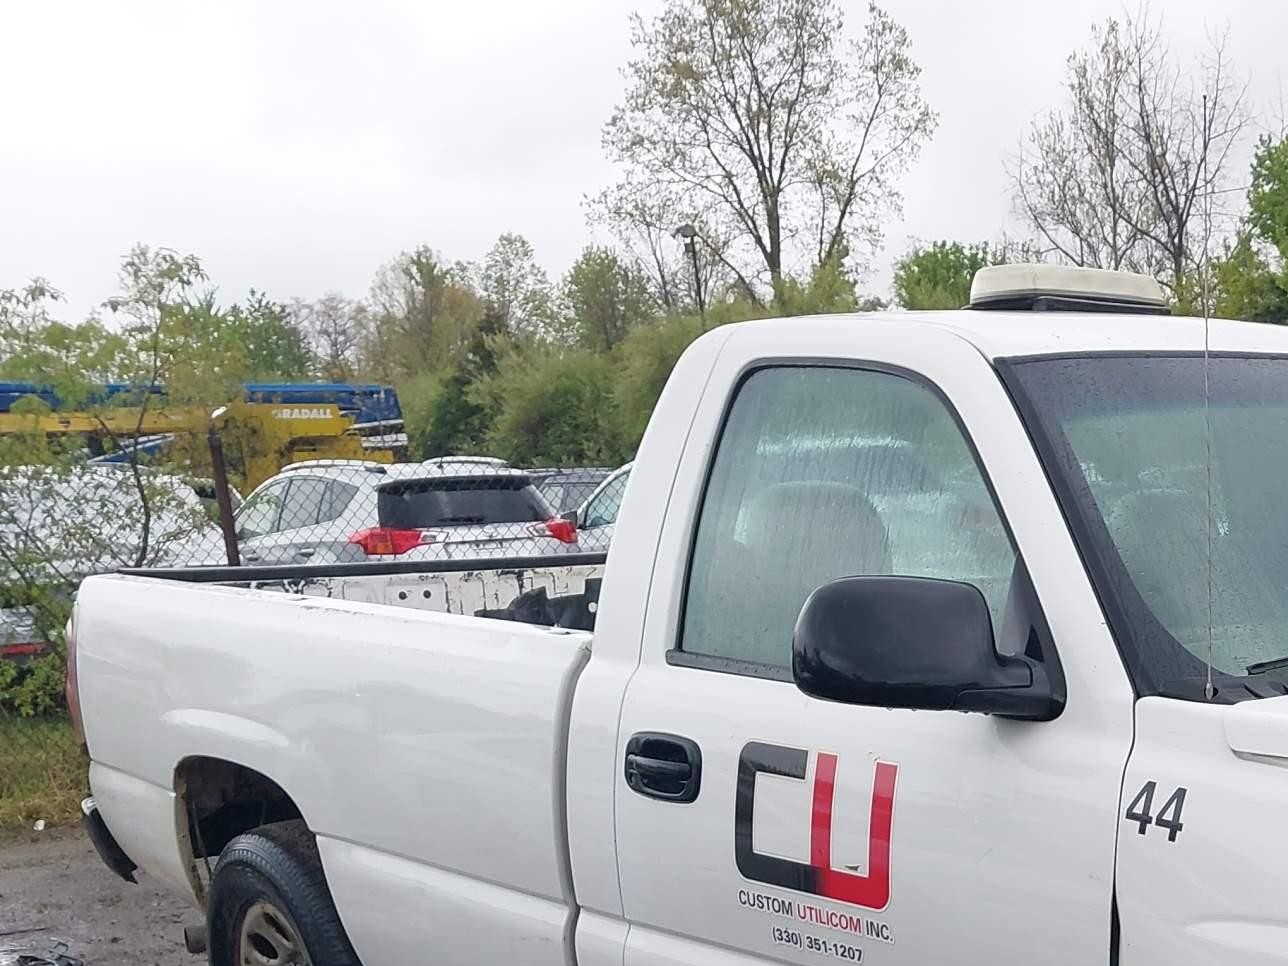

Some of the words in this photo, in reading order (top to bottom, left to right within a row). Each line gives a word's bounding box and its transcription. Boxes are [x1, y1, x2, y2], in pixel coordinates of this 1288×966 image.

[1125, 780, 1188, 843] 44
[738, 889, 793, 917] CUSTOM
[797, 903, 863, 934] UTILICOM
[865, 919, 894, 942] INC.
[772, 926, 803, 948] (330)
[806, 935, 863, 963] 351-1207
